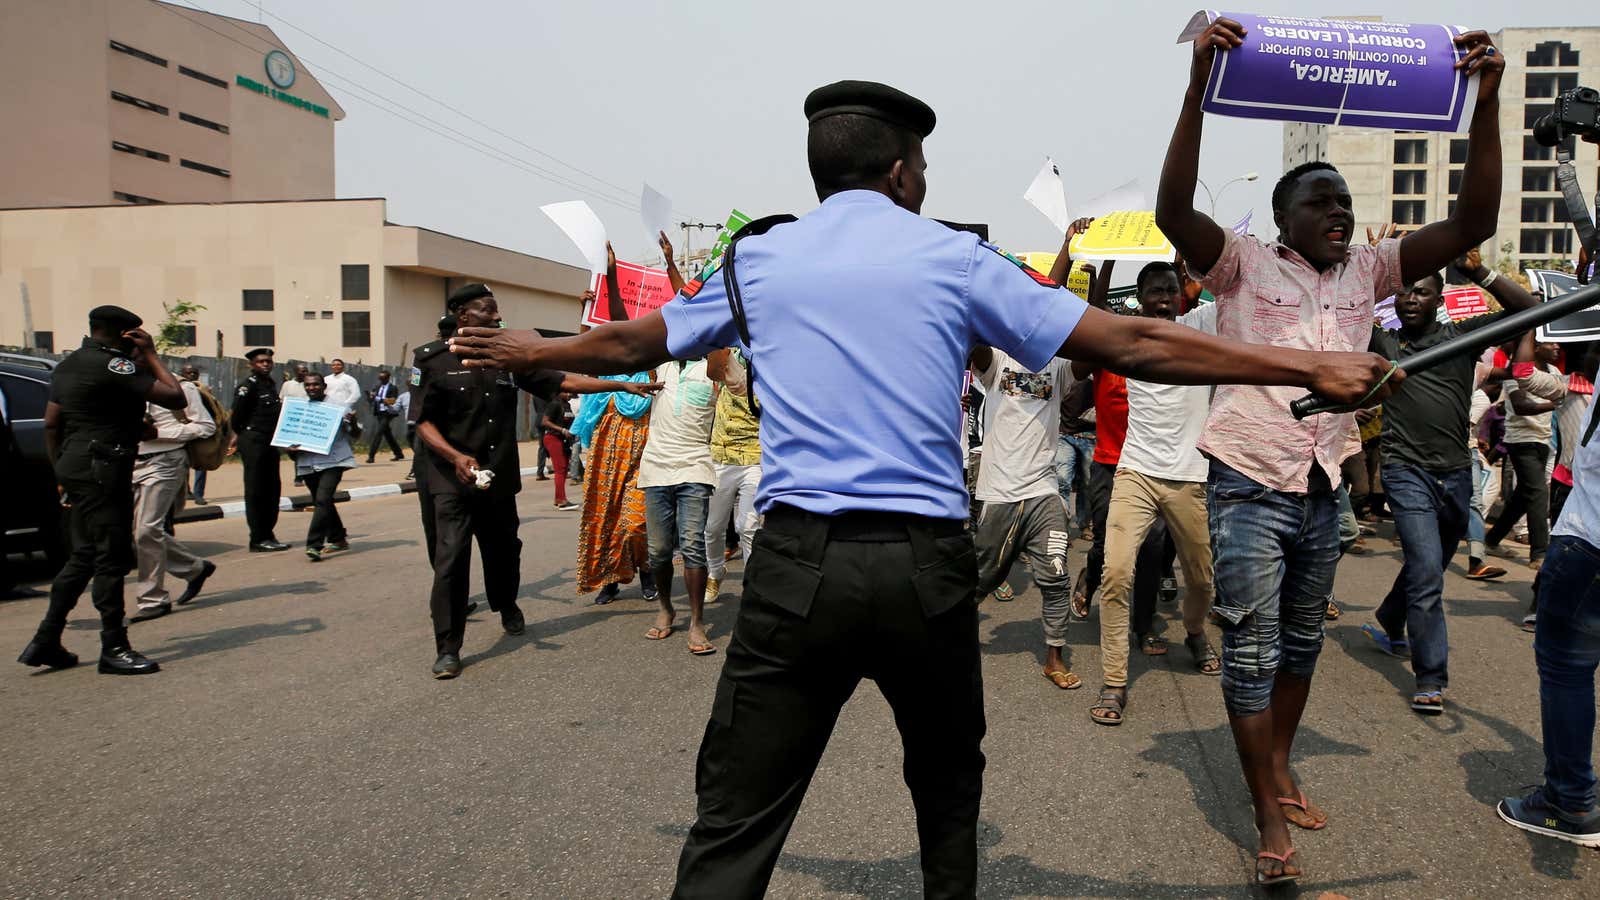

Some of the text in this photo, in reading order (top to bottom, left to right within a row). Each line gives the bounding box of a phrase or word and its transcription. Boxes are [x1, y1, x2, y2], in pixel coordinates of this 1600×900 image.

[1267, 18, 1329, 28] REFUGEES
[1332, 22, 1364, 31] MORE
[1367, 25, 1409, 34] EXPECT
[1257, 24, 1426, 49] CORRUPT LEADERS,
[1258, 42, 1427, 66] IF YOU CONTINUE TO SUPPORT
[1290, 59, 1397, 87] "AMERICA,
[637, 282, 662, 292] Japan
